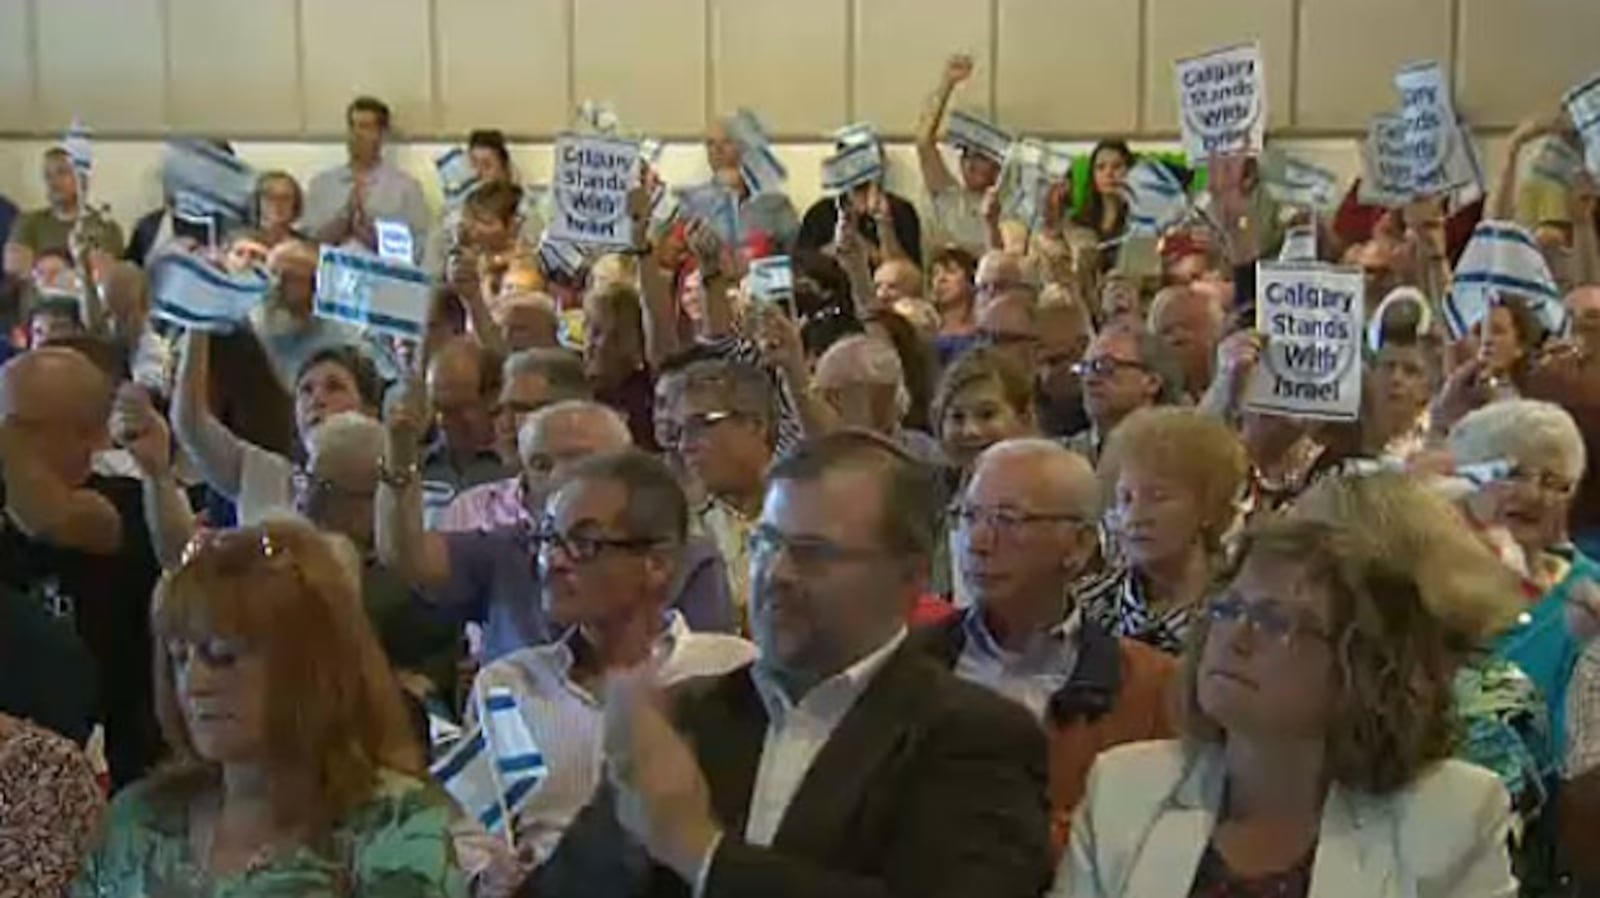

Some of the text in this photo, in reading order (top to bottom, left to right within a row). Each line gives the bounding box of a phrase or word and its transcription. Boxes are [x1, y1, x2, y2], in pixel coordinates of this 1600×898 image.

[1265, 281, 1355, 313] Calgary
[1272, 313, 1348, 340] Stands
[1284, 342, 1340, 371] With
[1272, 373, 1340, 401] Israel
